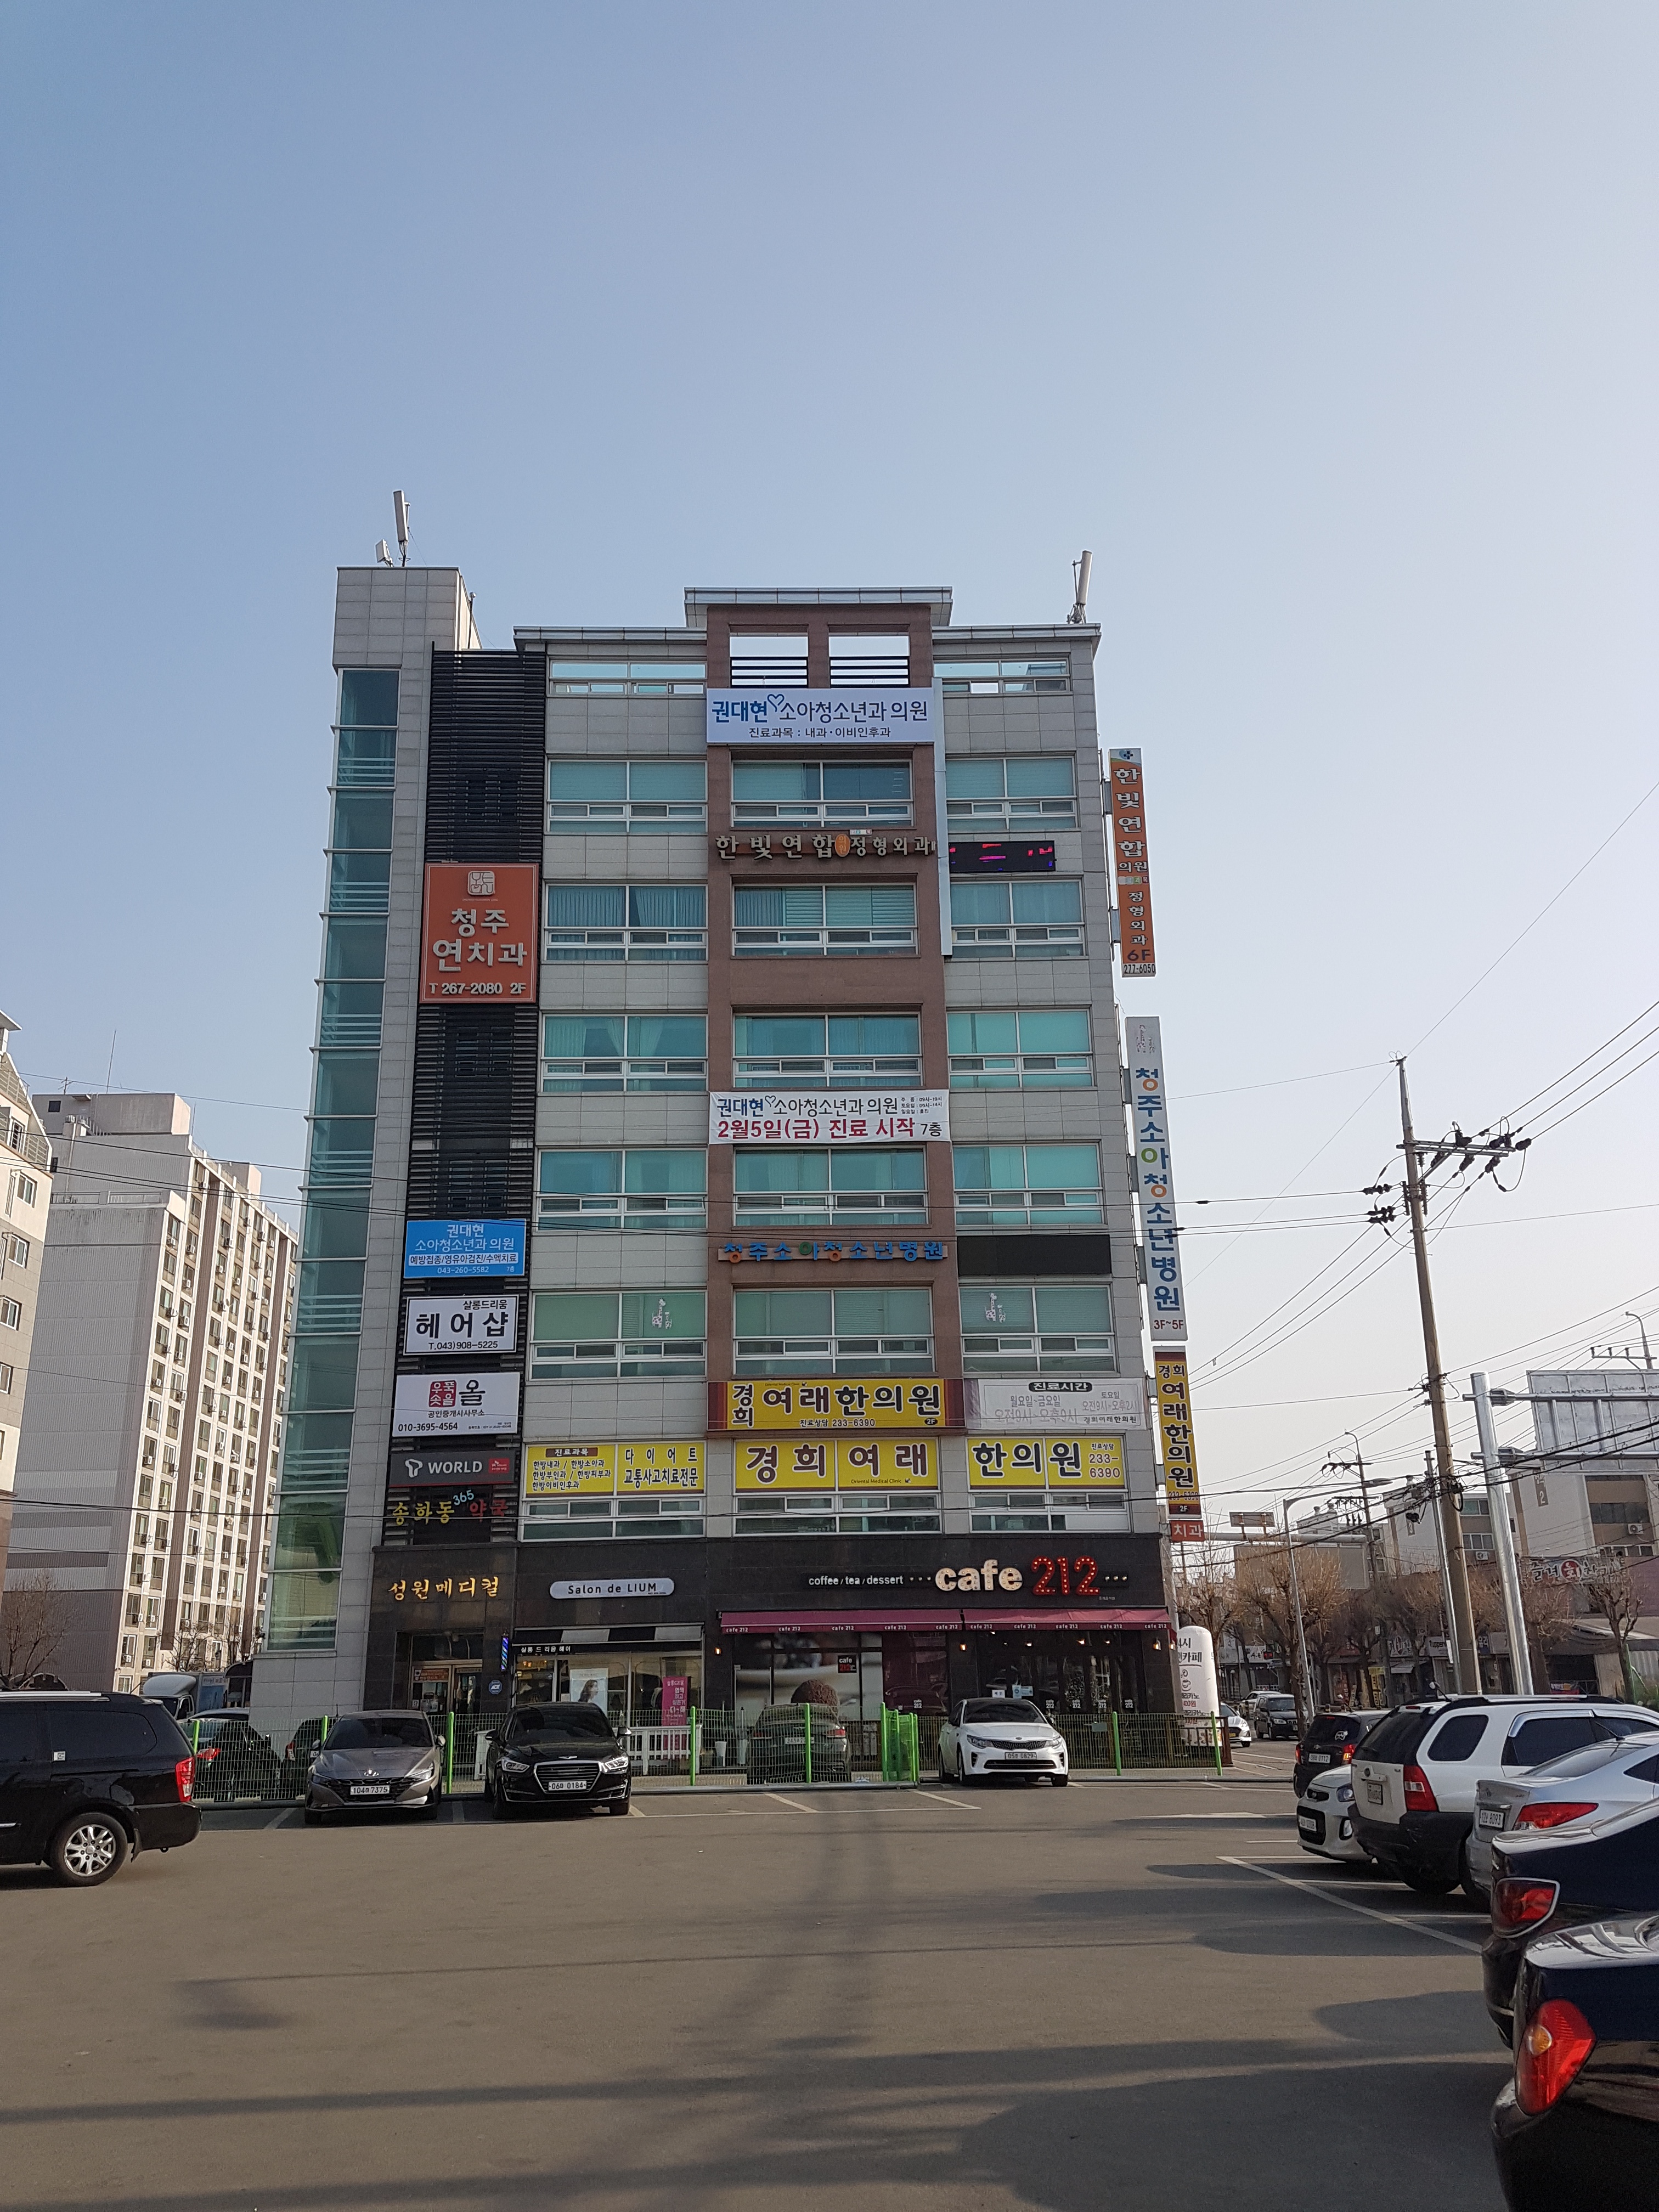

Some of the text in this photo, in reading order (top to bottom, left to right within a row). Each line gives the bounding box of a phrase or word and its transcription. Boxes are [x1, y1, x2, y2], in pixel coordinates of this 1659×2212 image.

[712, 701, 928, 724] 권대현 소아청소년과 의원
[749, 727, 793, 738] 진료과목
[1114, 768, 1146, 857] 한빛연합
[715, 834, 931, 860] 한빛연합 의원 정형외과
[1118, 861, 1148, 872] 의원
[451, 908, 509, 938] 청주
[1128, 891, 1148, 945] 정형외과
[432, 939, 527, 972] 연치과
[1127, 949, 1151, 961] 6F
[1124, 964, 1155, 974] 277-6050
[429, 982, 527, 995] T 267-2080 2F
[717, 1097, 898, 1118] 권대현 소아청소년과 의원
[718, 1117, 942, 1139] 2월5일(금) 진료 시작 7층
[1135, 1068, 1180, 1311] 청주소아청소년병원
[447, 1224, 484, 1238] 권대현
[415, 1238, 514, 1252] 소아청소년과 의원
[724, 1242, 943, 1263] 청주소아청소년병원
[462, 1299, 507, 1310] 살롱드리움
[416, 1311, 509, 1339] 헤어샵
[1154, 1319, 1184, 1330] 3F~5F
[1159, 1364, 1185, 1379] 경희
[459, 1379, 486, 1407] 올
[1034, 1382, 1088, 1391] 진료시간
[732, 1384, 941, 1427] 경희 여래한의원
[398, 1422, 458, 1431] 010-3695-4564
[800, 1418, 828, 1427] 진료상담
[832, 1418, 876, 1427] 233-6390
[1161, 1381, 1194, 1488] 여래한의원
[554, 1448, 589, 1457] 진료과목
[625, 1447, 697, 1465] 다이어트
[973, 1442, 1081, 1478] 한의원
[428, 1460, 482, 1474] WORLD
[533, 1459, 605, 1469] 한방내과 한방소아과
[533, 1470, 611, 1480] 한방부인과 한방피부과
[624, 1468, 698, 1489] 교통사고치료전문
[1089, 1467, 1120, 1479] 6390
[532, 1481, 579, 1491] 한방이비인후과
[453, 1489, 475, 1505] 365
[470, 1499, 509, 1523] 약국
[1173, 1523, 1203, 1538] 치과
[808, 1574, 904, 1586] coffee tea dessert
[935, 1555, 1099, 1596] cafe 212
[388, 1576, 500, 1601] 성원메디컬
[568, 1583, 656, 1594] Salon de LIUM
